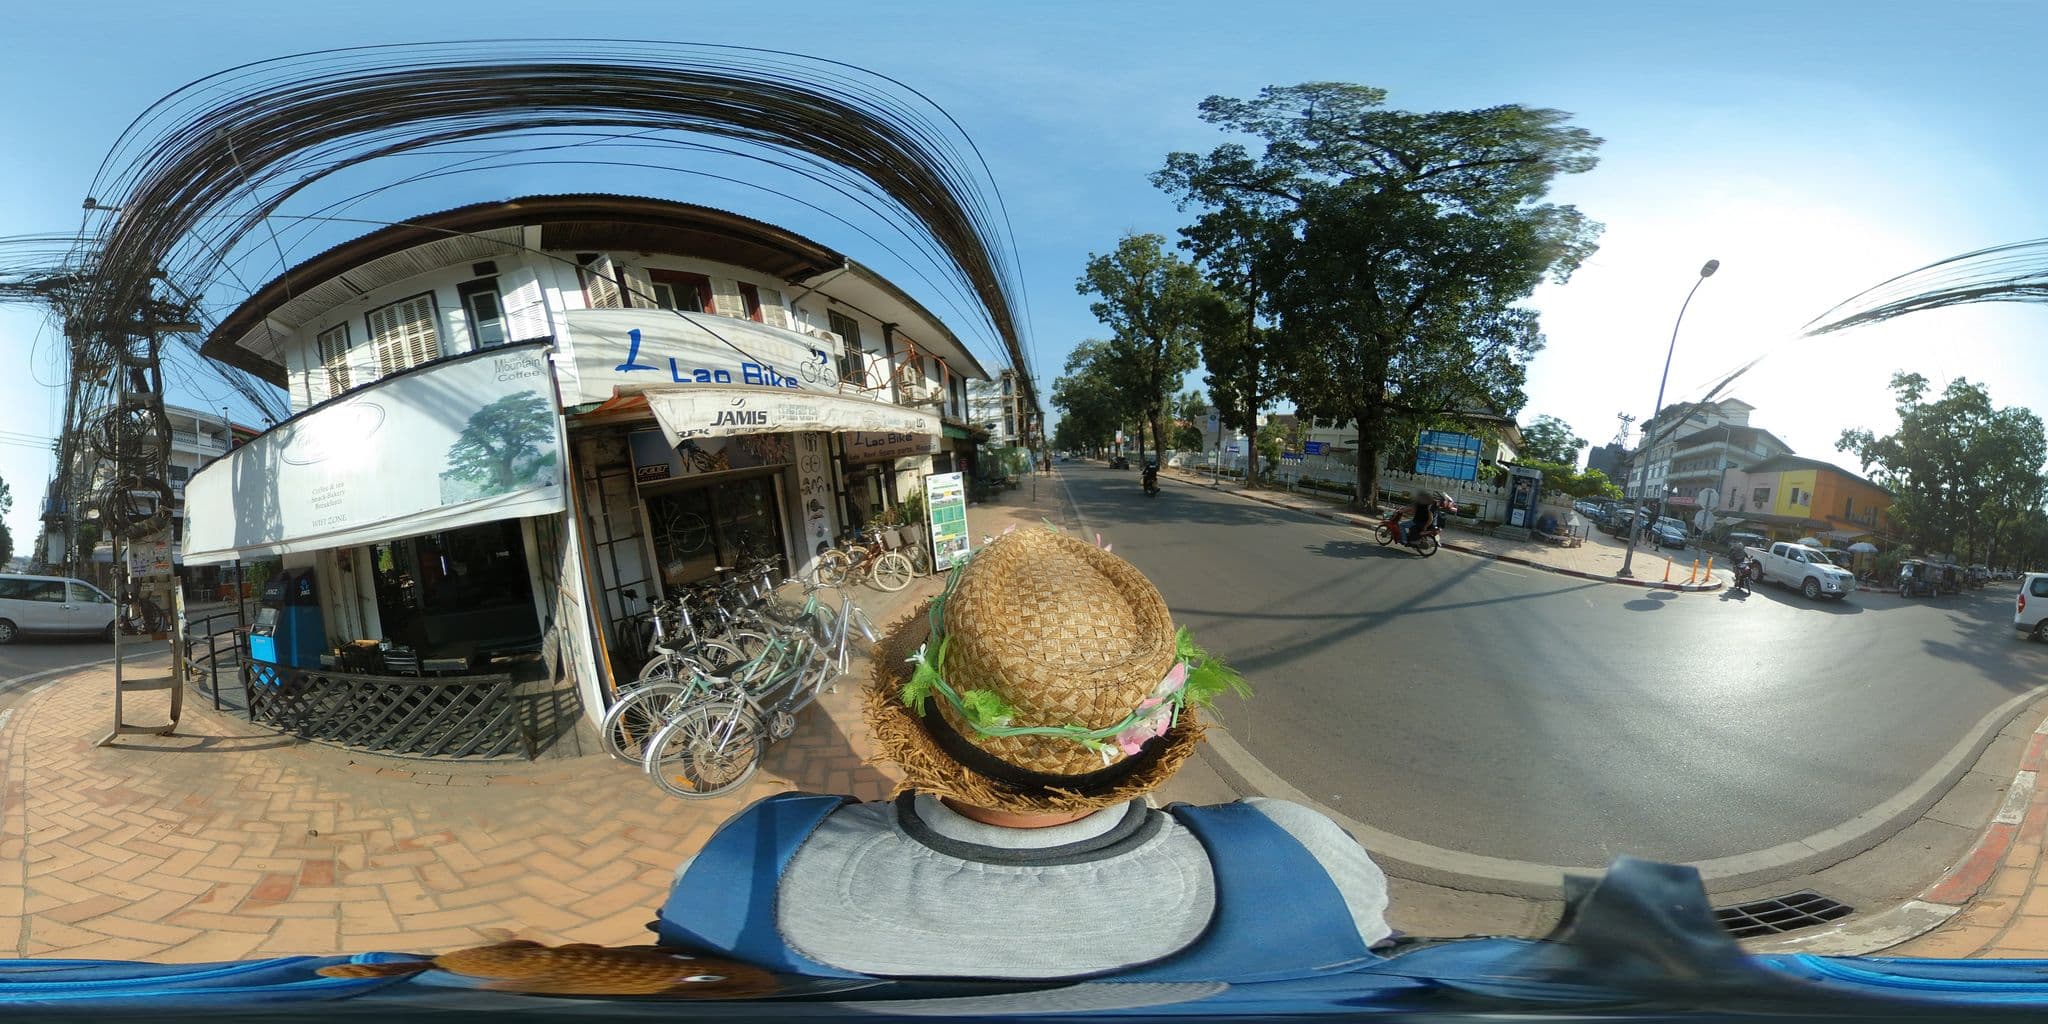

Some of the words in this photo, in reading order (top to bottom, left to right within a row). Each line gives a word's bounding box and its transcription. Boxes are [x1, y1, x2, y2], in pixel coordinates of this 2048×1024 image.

[494, 358, 541, 374] Mountain
[669, 357, 731, 384] Lao
[741, 361, 800, 389] Bike
[497, 370, 541, 382] Coffee
[709, 411, 767, 427] JAMIS
[865, 437, 885, 448] Lao
[887, 433, 913, 445] Bike
